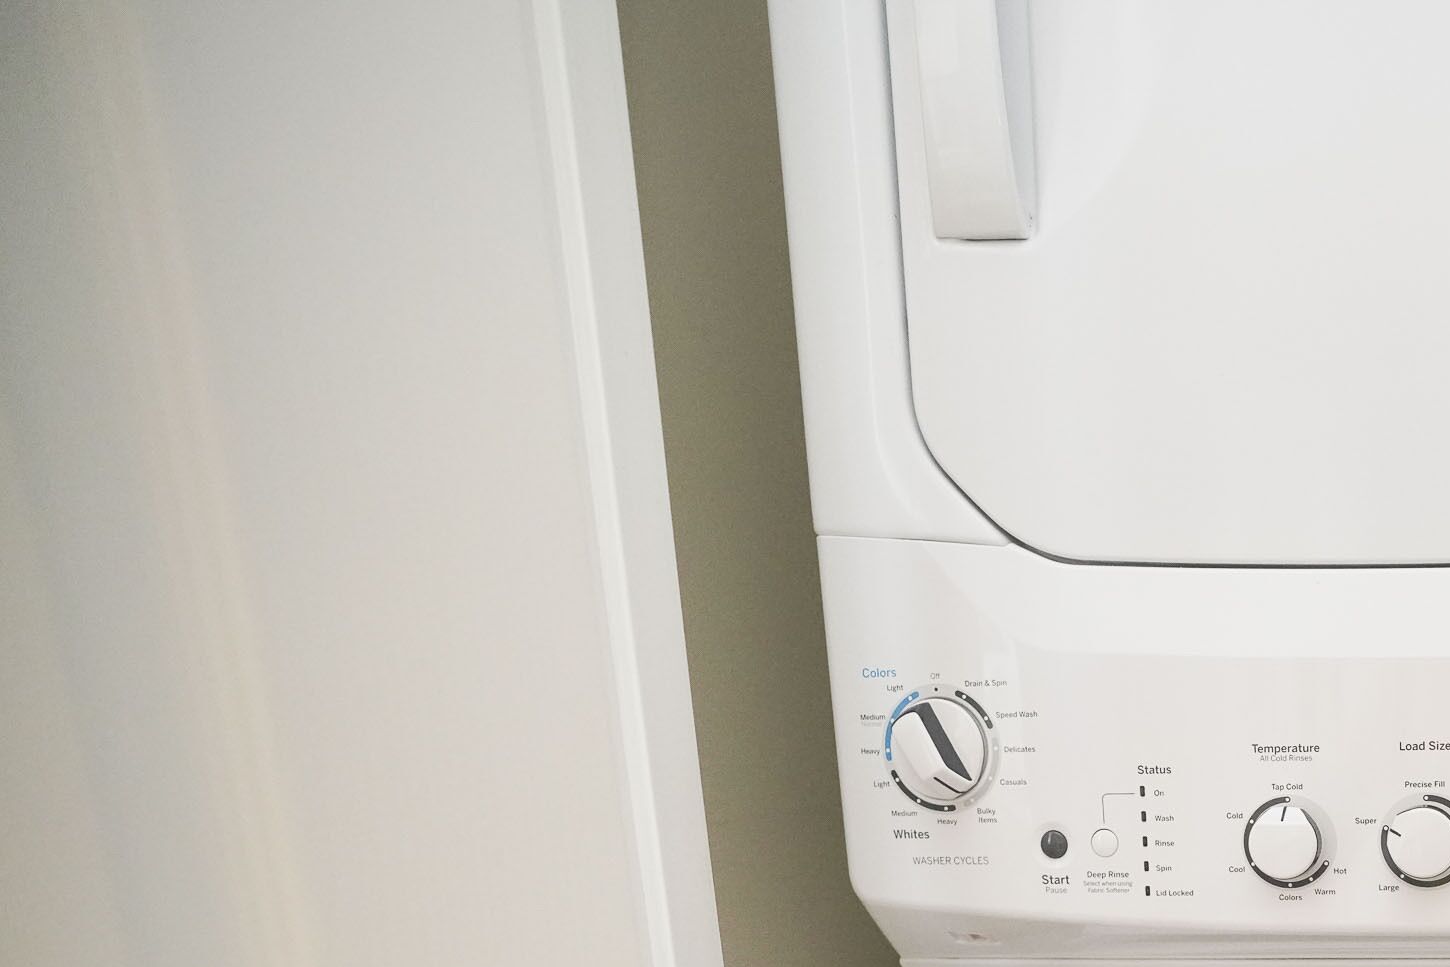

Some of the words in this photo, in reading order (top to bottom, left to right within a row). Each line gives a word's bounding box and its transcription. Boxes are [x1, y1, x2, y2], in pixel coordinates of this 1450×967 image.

[862, 667, 897, 678] Colors
[930, 672, 940, 680] Off
[860, 713, 886, 721] Medium
[995, 711, 1018, 719] Speed
[1252, 743, 1320, 755] Temperature
[1399, 741, 1426, 751] Load
[1137, 765, 1172, 775] Status
[873, 780, 890, 788] Light
[1271, 783, 1284, 792] Tap
[1404, 780, 1432, 788] Precise
[1434, 780, 1446, 788] Fill
[1153, 789, 1165, 797] On
[1226, 812, 1243, 820] Cold
[937, 818, 958, 826] Heavy
[1354, 817, 1377, 826] Super
[893, 829, 930, 839] Whites
[912, 856, 952, 865] WASHER
[953, 856, 990, 865] CYCLES
[1155, 864, 1172, 872] Spin
[1087, 870, 1107, 879] Deep
[1108, 870, 1130, 878] Rinse
[1041, 874, 1070, 885] Start
[1045, 886, 1068, 894] Pause
[1314, 888, 1336, 896] Warm
[1378, 884, 1400, 893] Large
[1168, 889, 1194, 897] Locked
